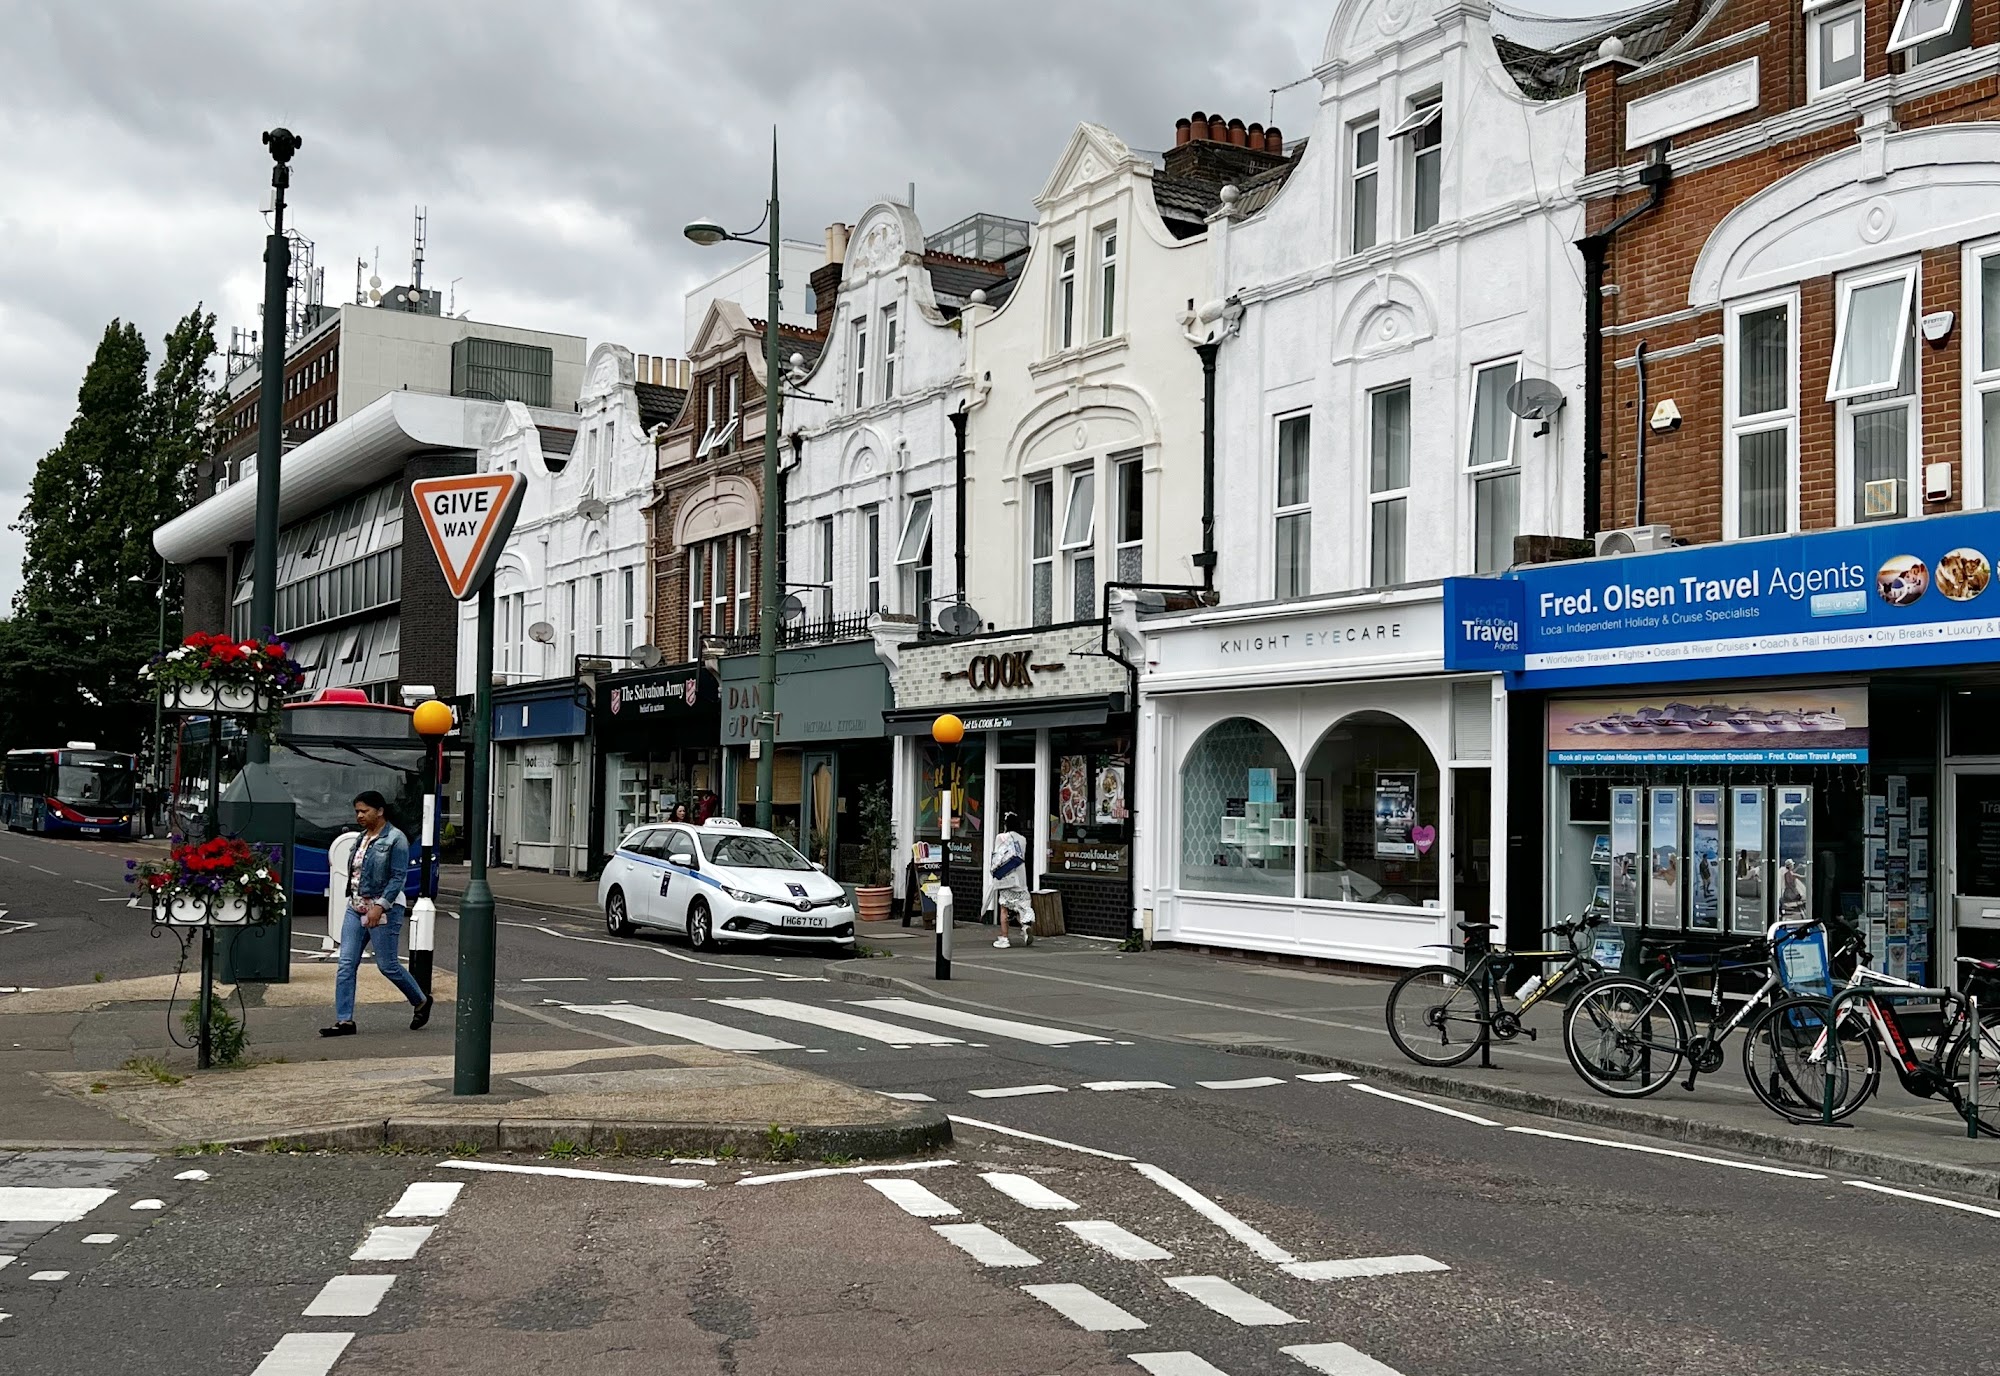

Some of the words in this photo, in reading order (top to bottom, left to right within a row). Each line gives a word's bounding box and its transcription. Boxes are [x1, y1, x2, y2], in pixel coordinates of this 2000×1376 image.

[434, 491, 488, 515] GIVE
[444, 521, 477, 537] WAY
[1540, 589, 1598, 617] Fred.
[1604, 584, 1675, 611] Olsen
[1679, 570, 1759, 604] Travel
[1768, 562, 1864, 599] Agents
[1567, 619, 1622, 634] Independent
[1625, 616, 1660, 628] Holiday
[1662, 614, 1669, 625] &
[1672, 613, 1703, 624] Cruise
[1705, 607, 1760, 622] Specialists
[1220, 635, 1290, 653] KNIGHT
[1306, 624, 1401, 646] EYECARE
[1462, 620, 1518, 642] Travel
[1494, 641, 1518, 652] Agents
[1546, 654, 1585, 664] Worldwide
[1587, 652, 1610, 662] Travel
[1619, 649, 1645, 661] Flights
[1654, 647, 1681, 657] Ocean
[1683, 645, 1689, 655] &
[1692, 644, 1713, 654] River
[1716, 642, 1750, 652] Cruises
[1760, 638, 1790, 649] Coach
[1792, 636, 1799, 647] &
[1802, 635, 1820, 646] Rail
[1823, 632, 1865, 645] Holidays
[1876, 629, 1897, 642] City
[1899, 627, 1934, 639] Breaks
[1947, 623, 1983, 636] Luxury
[1986, 622, 1993, 633] &
[968, 650, 1033, 690] COOK
[621, 686, 633, 701] The
[634, 682, 664, 700] Salvation
[665, 681, 684, 699] Army
[978, 719, 994, 729] COOK
[1582, 754, 1595, 762] your
[1616, 753, 1642, 762] Holidays
[1643, 753, 1656, 761] with
[1668, 753, 1685, 761] Local
[1686, 753, 1726, 762] Independent
[1727, 753, 1763, 762] Specialists
[1787, 752, 1807, 760] Olsen
[1808, 752, 1830, 760] Travel
[1831, 752, 1857, 761] Agents
[1780, 819, 1807, 827] Thailand
[1064, 849, 1119, 860] www.cookfood.net
[786, 916, 807, 926] HG67
[808, 917, 823, 926] TCX
